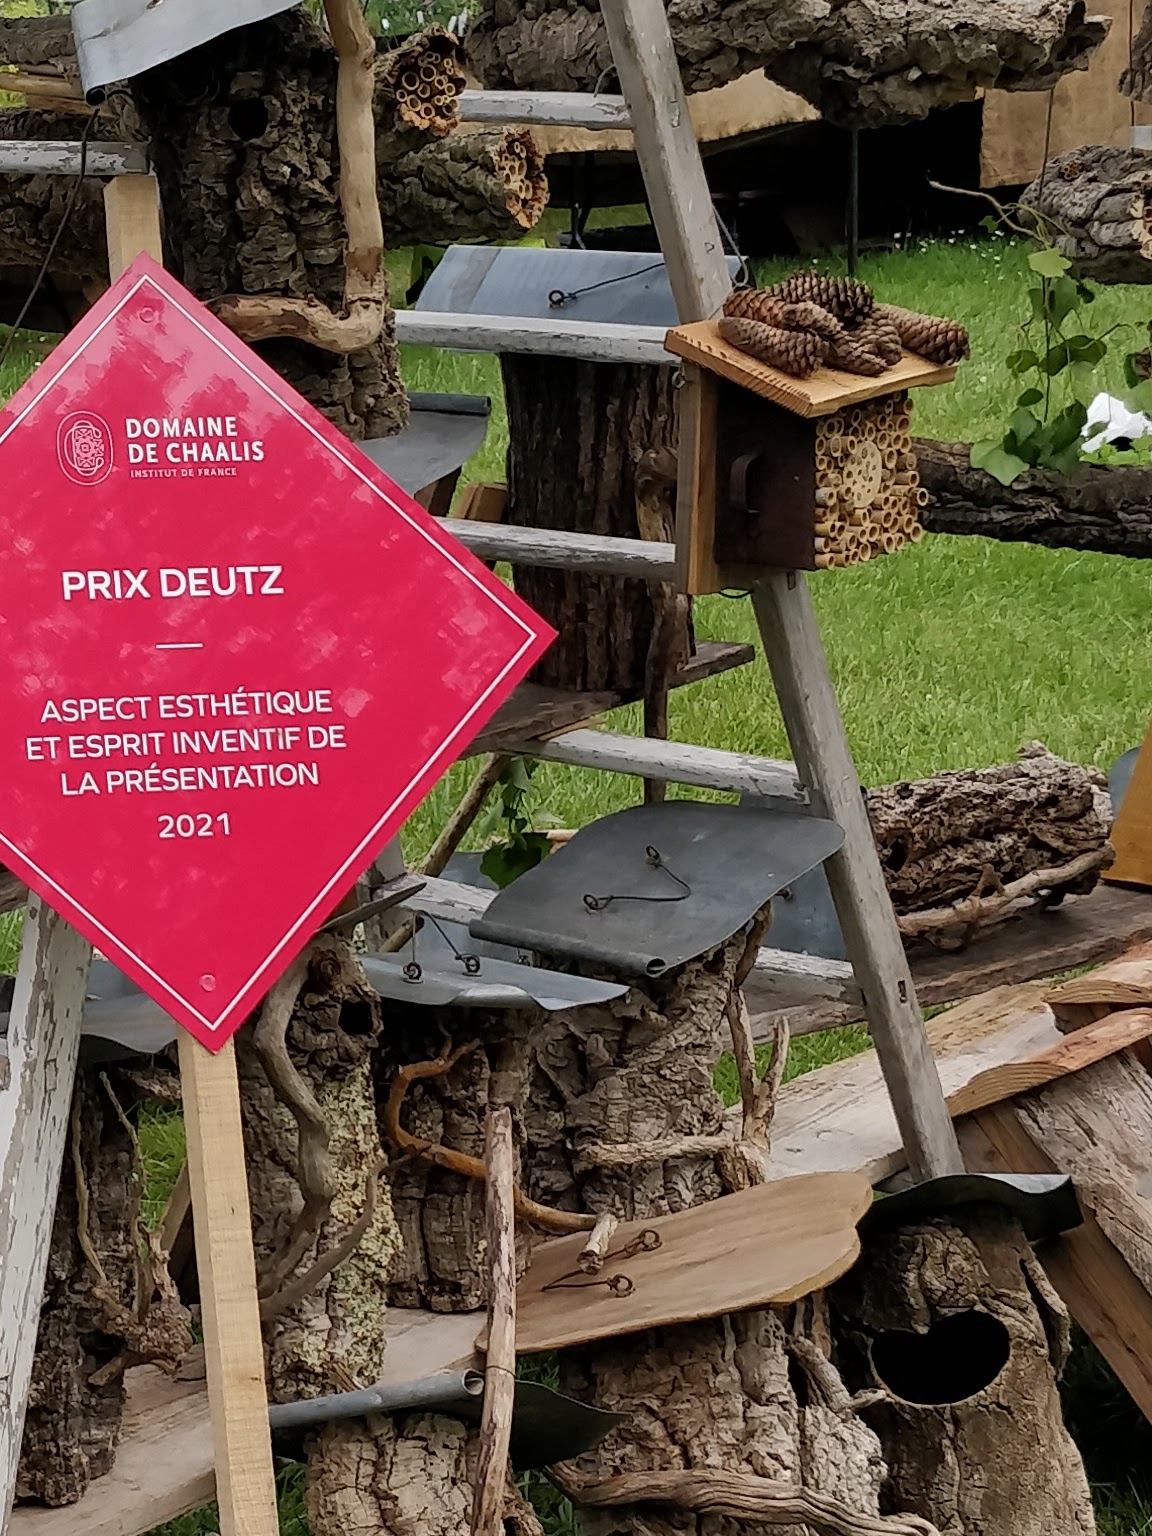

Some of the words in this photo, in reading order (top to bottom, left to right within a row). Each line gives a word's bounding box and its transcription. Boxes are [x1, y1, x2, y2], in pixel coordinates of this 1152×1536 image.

[125, 416, 238, 439] DOMAINE
[128, 443, 159, 464] DE
[166, 440, 265, 463] CHAALIS
[130, 468, 178, 478] INSTITUT
[180, 468, 195, 477] DE
[197, 467, 237, 477] FRANCE
[62, 569, 151, 601] PRIX
[159, 565, 284, 597] DEUTZ
[40, 696, 152, 723] ASPECT
[158, 686, 333, 718] ESTHÉTIQUE
[26, 736, 61, 760] ET
[68, 732, 166, 759] ESPRIT
[172, 726, 301, 754] INVENTIF
[307, 725, 347, 749] DE
[61, 772, 101, 796] LA
[106, 762, 319, 794] PRÉSENTATION
[158, 812, 230, 838] 2021
